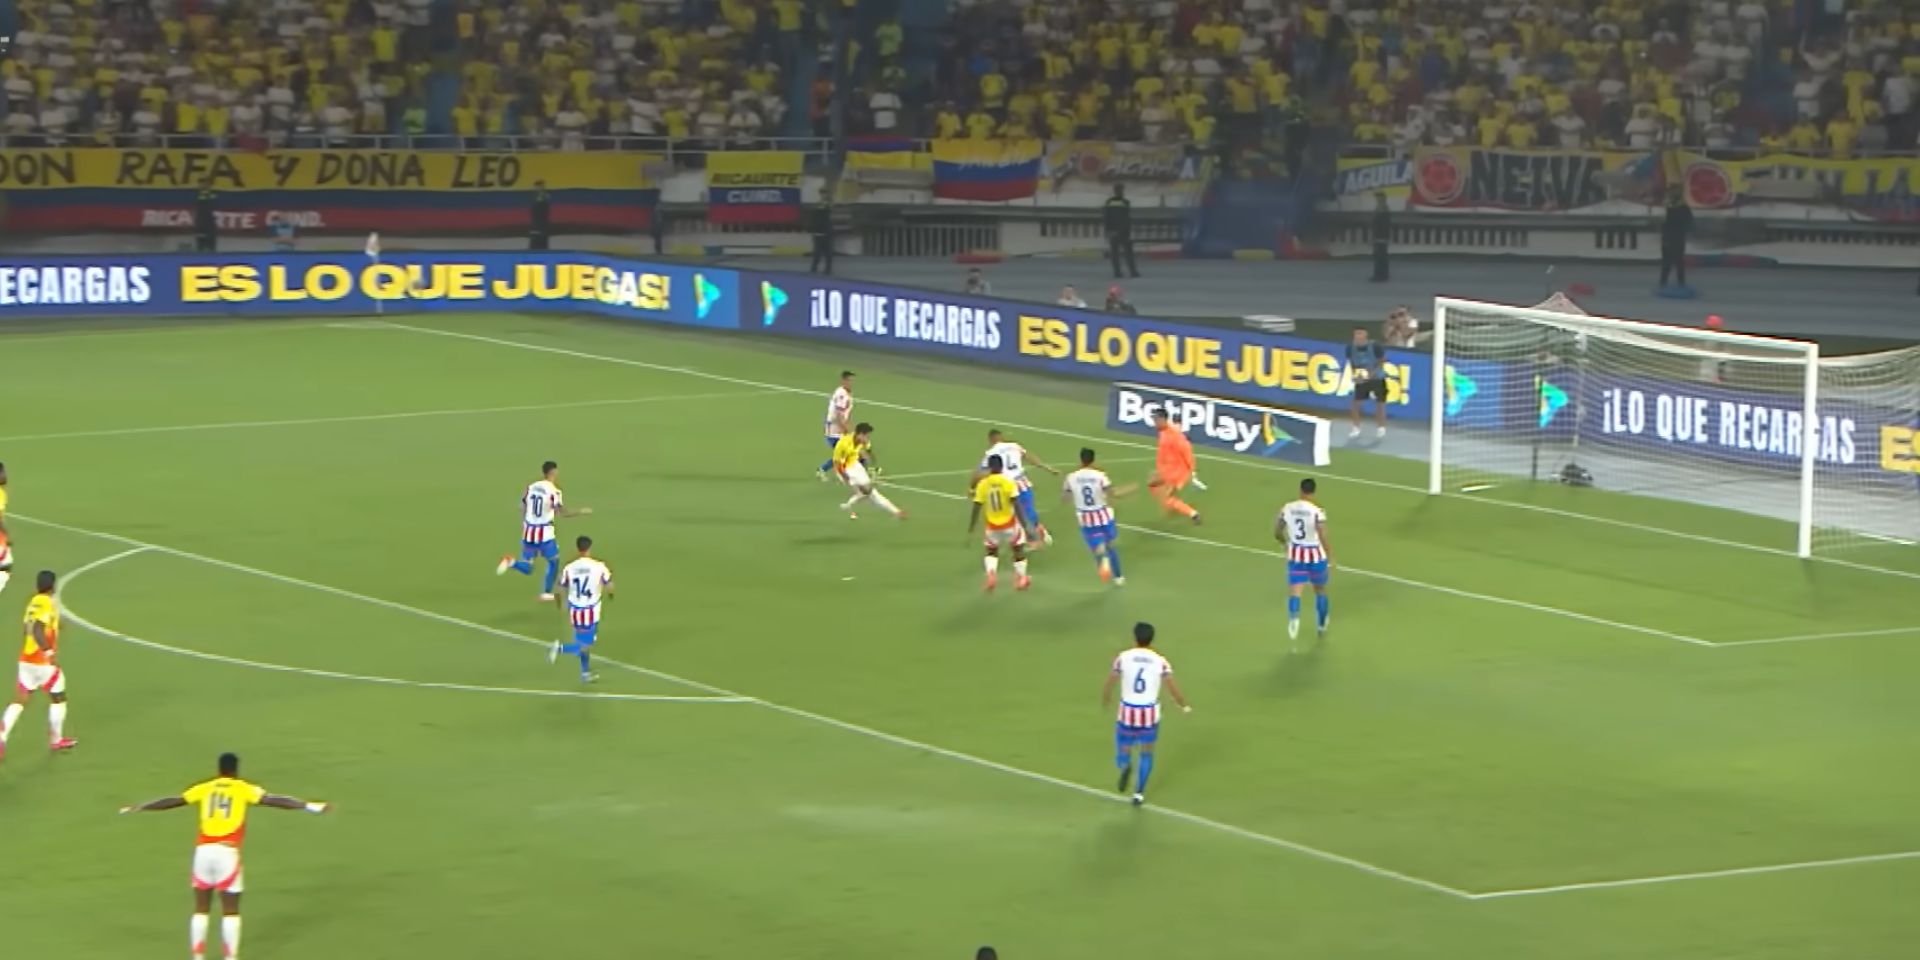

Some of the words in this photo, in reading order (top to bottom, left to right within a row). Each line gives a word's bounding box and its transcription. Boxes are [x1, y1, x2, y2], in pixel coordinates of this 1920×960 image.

[116, 152, 245, 187] RAFA
[451, 155, 522, 188] LEO
[181, 265, 261, 301] ES
[269, 264, 352, 300] LO
[360, 264, 485, 300] QUE
[492, 264, 671, 310] JUEGAS!
[811, 289, 843, 328] ¡LO
[850, 292, 888, 335] QUE
[895, 298, 1001, 349] RECARGAS
[1018, 315, 1072, 358] ES
[1076, 322, 1131, 367] LO
[1136, 331, 1221, 379] QUE
[1118, 390, 1261, 452] BetPlay
[1656, 394, 1709, 444] QUE
[530, 493, 544, 518] 10
[989, 487, 1003, 513] 11
[1081, 485, 1095, 507] 8
[1295, 518, 1306, 541] 3
[573, 576, 593, 599] 14
[1133, 667, 1146, 694] 6
[208, 791, 233, 819] 14
